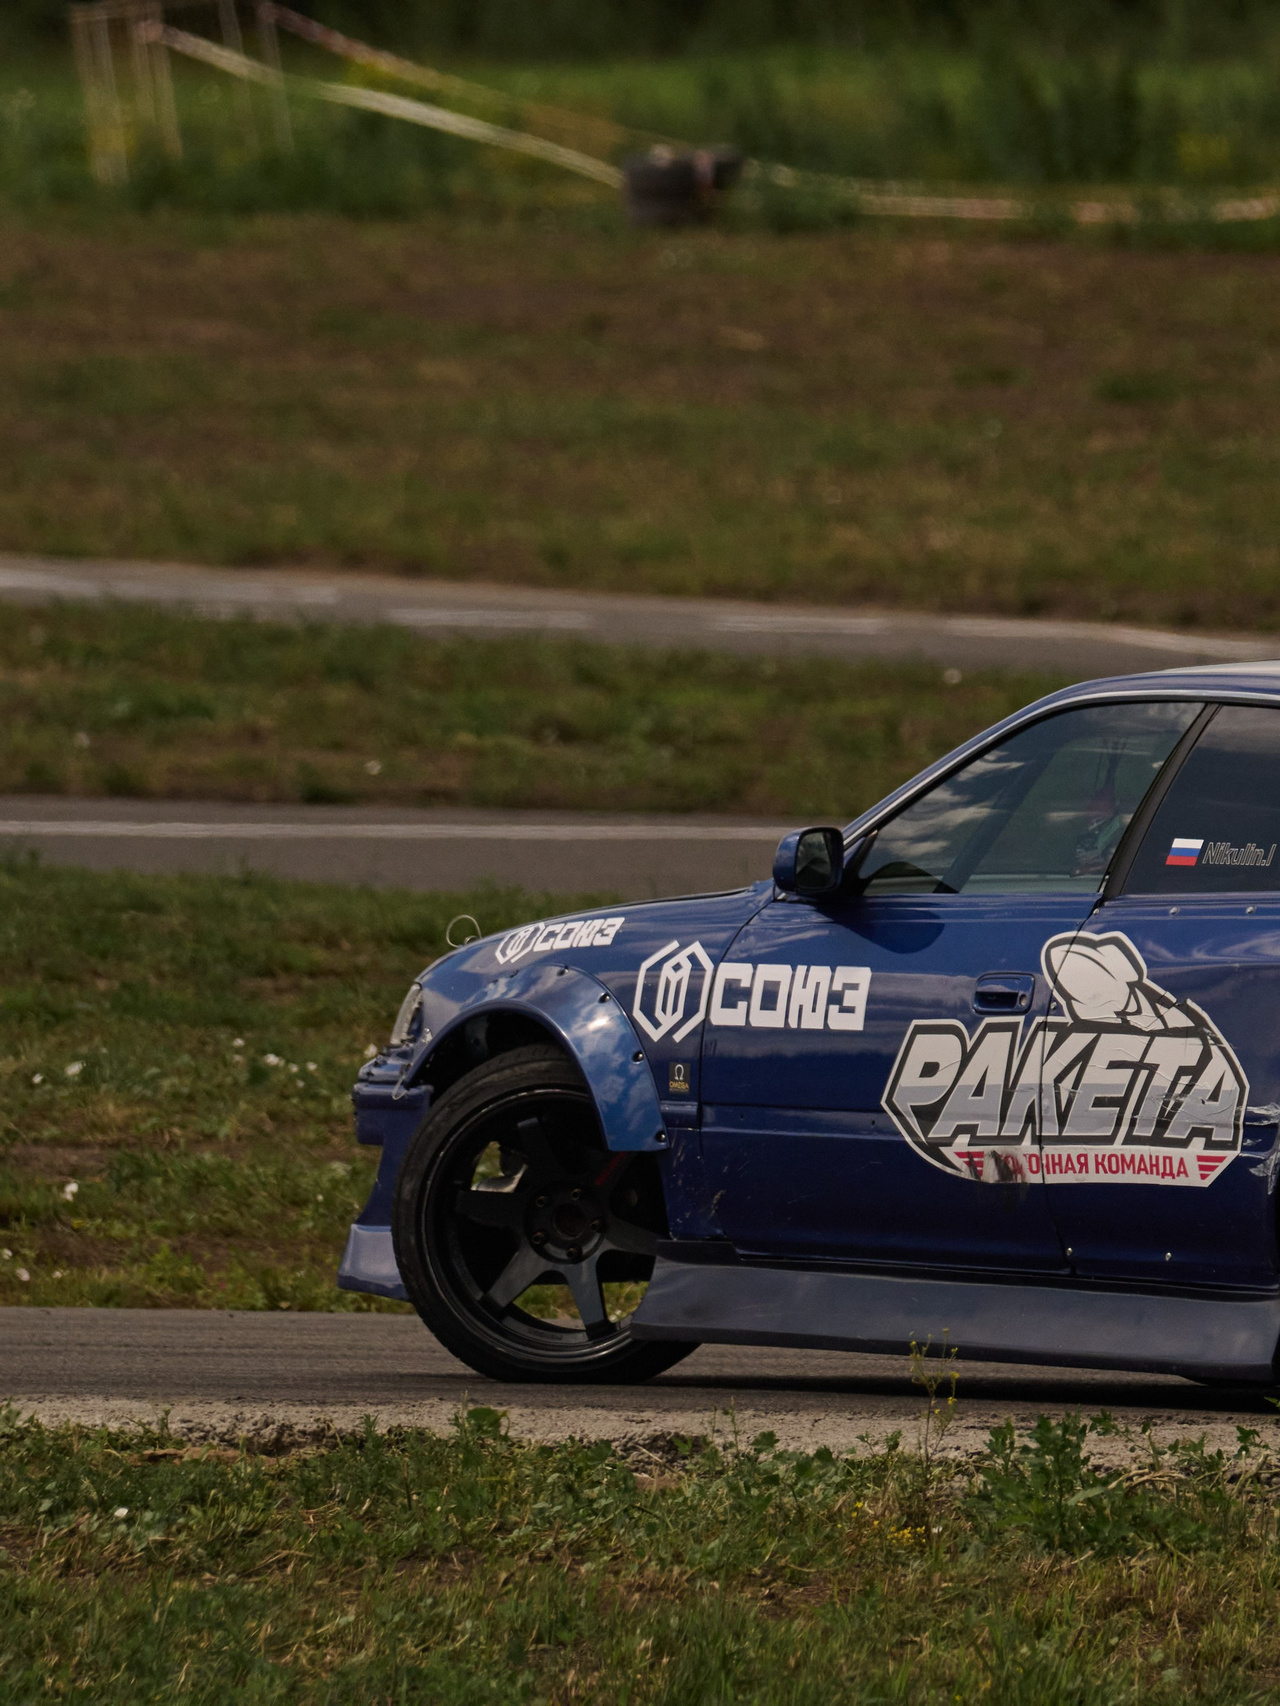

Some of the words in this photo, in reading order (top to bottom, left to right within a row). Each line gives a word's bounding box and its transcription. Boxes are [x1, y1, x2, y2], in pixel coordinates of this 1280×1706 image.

[533, 917, 626, 952] СОЮЗ
[709, 962, 871, 1031] СОЮЗ
[890, 1030, 1242, 1146] РАКЕТА
[1094, 1153, 1189, 1179] КОМАНДА
